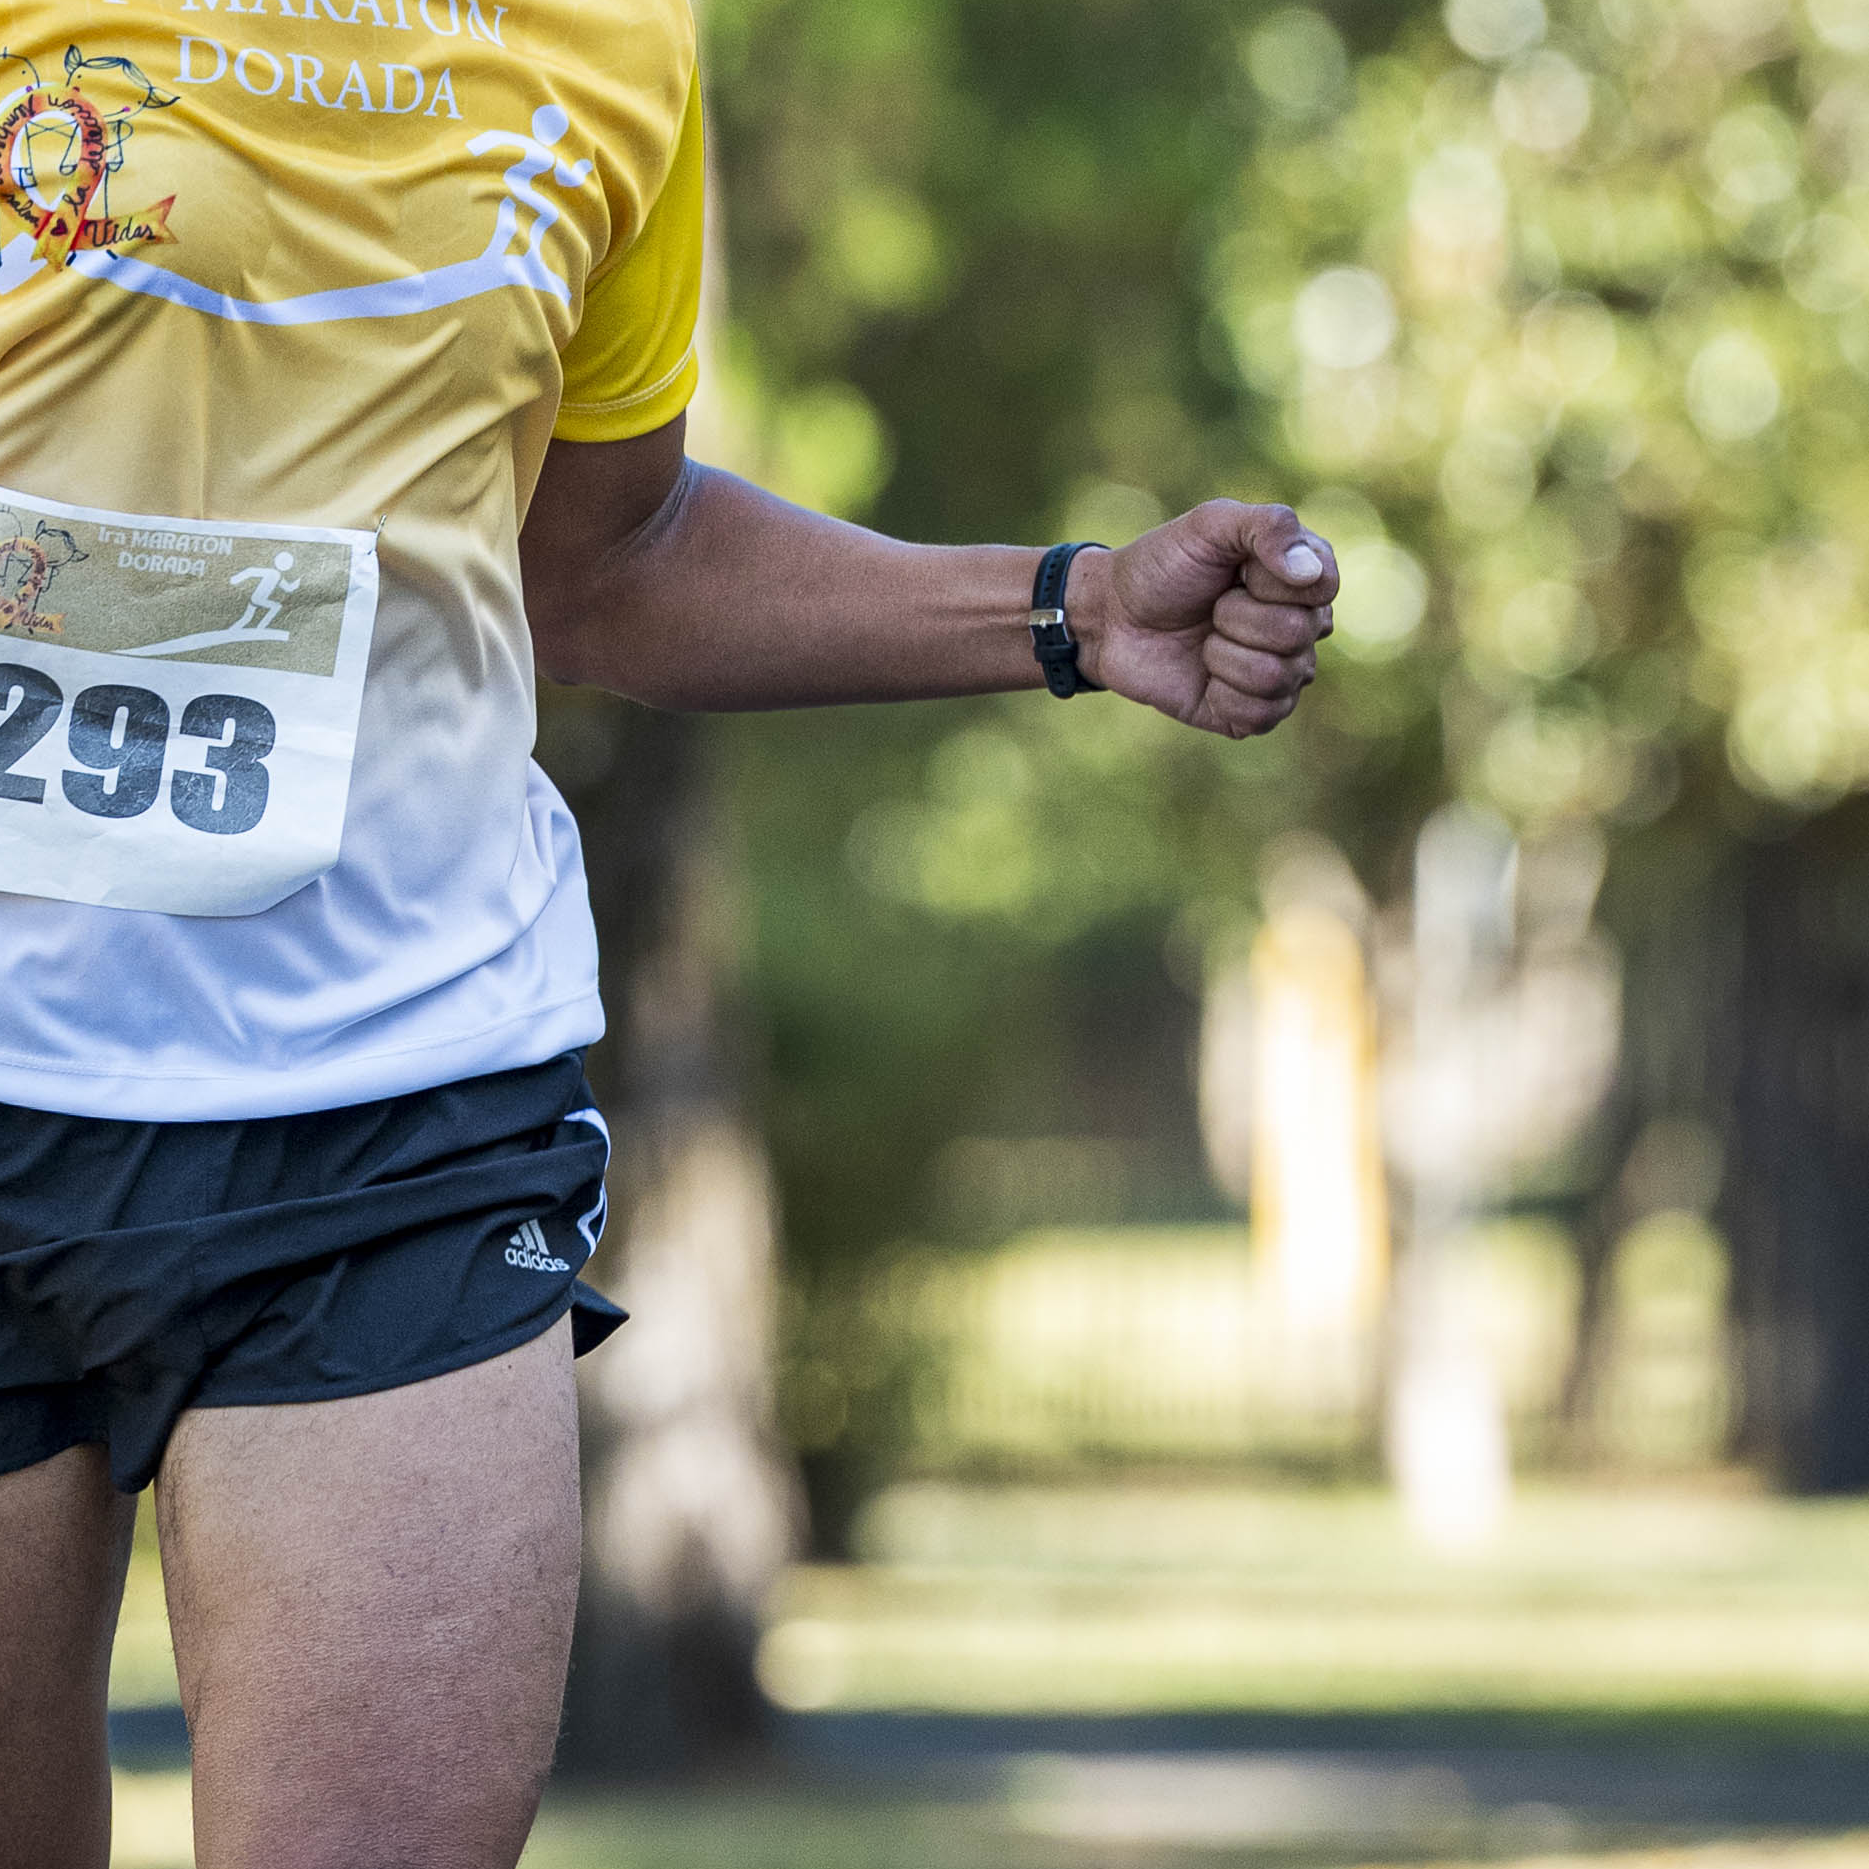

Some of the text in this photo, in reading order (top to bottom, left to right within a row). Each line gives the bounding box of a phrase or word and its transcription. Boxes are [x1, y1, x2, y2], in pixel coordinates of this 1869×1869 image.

[173, 35, 464, 120] DORADA
[118, 550, 206, 576] DORADA
[504, 1246, 570, 1272] adidas
